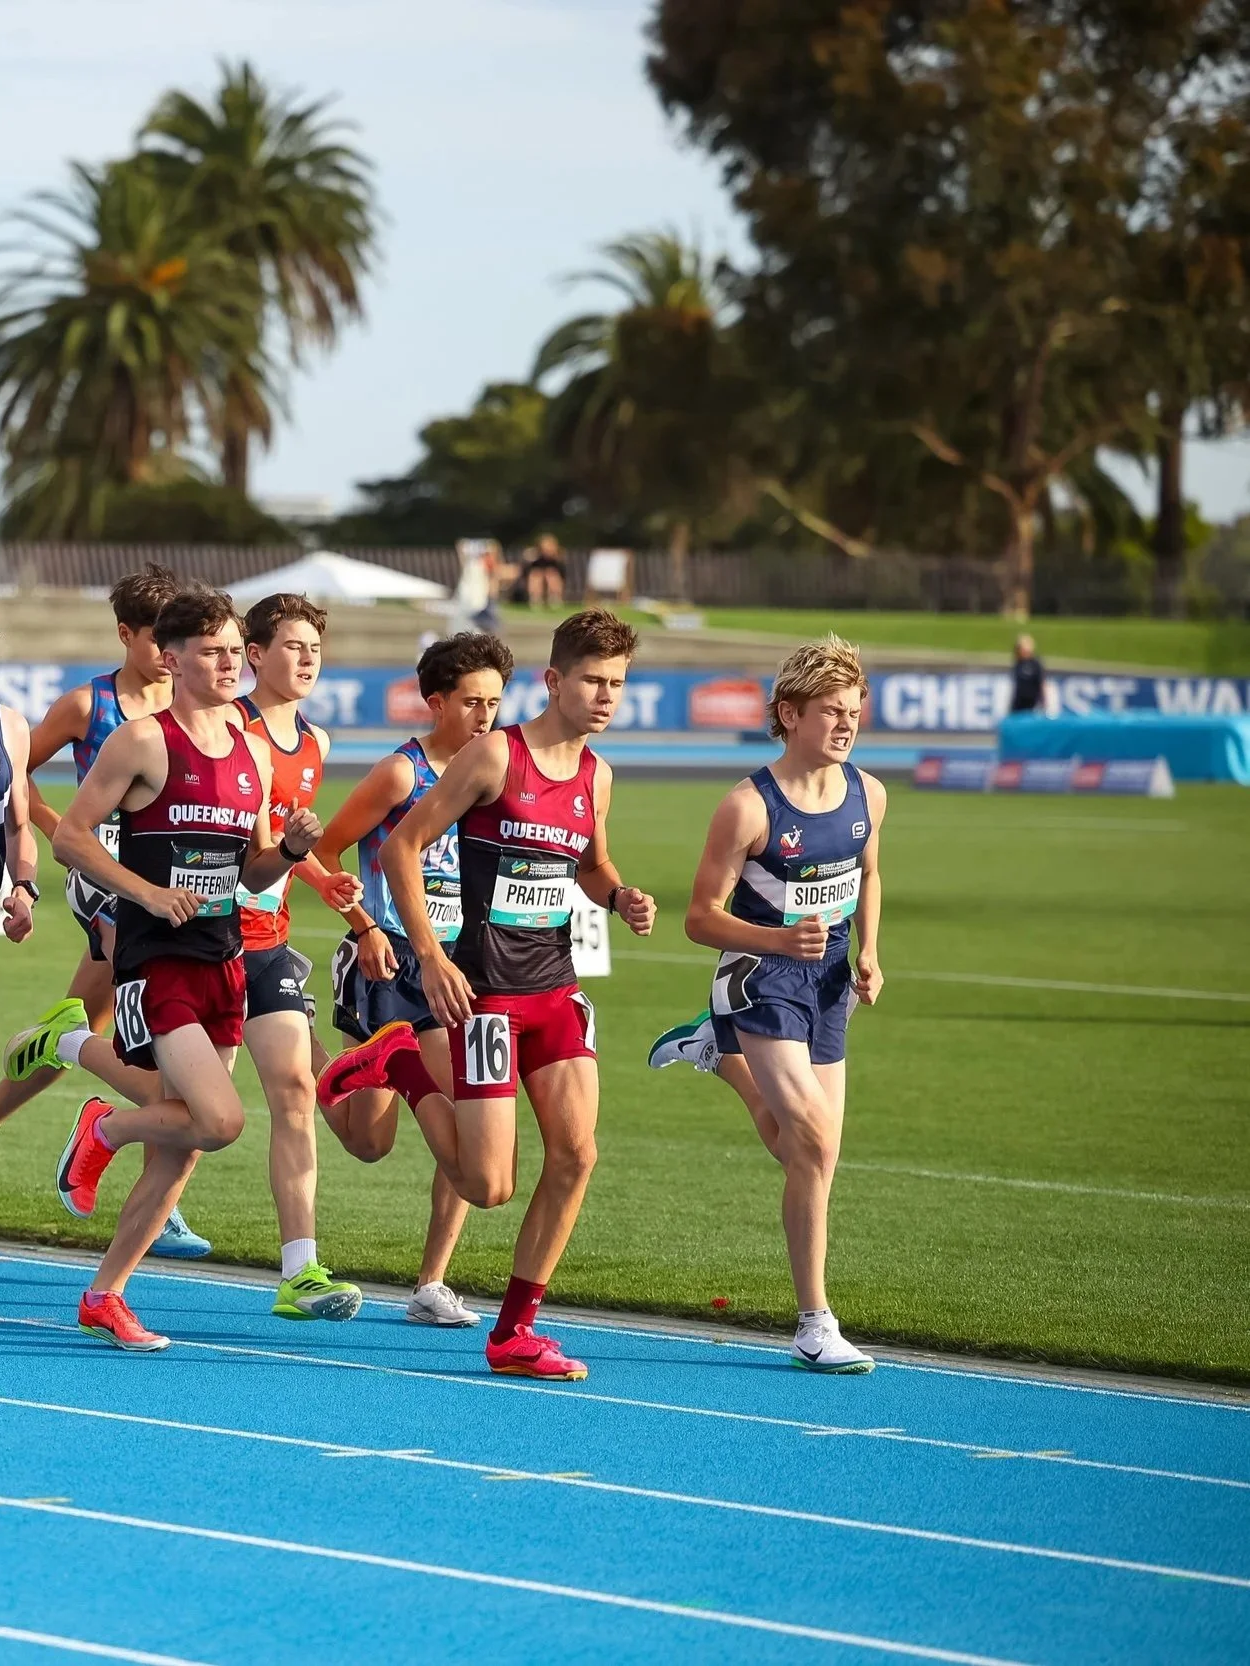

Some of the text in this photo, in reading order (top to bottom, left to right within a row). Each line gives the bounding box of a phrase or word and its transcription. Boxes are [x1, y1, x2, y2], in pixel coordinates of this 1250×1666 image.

[176, 873, 236, 895] HEFFERNAN
[506, 883, 565, 906] PRATTEN
[795, 878, 855, 906] SIDERIDIS
[116, 982, 146, 1048] 18
[467, 1016, 508, 1082] 16
